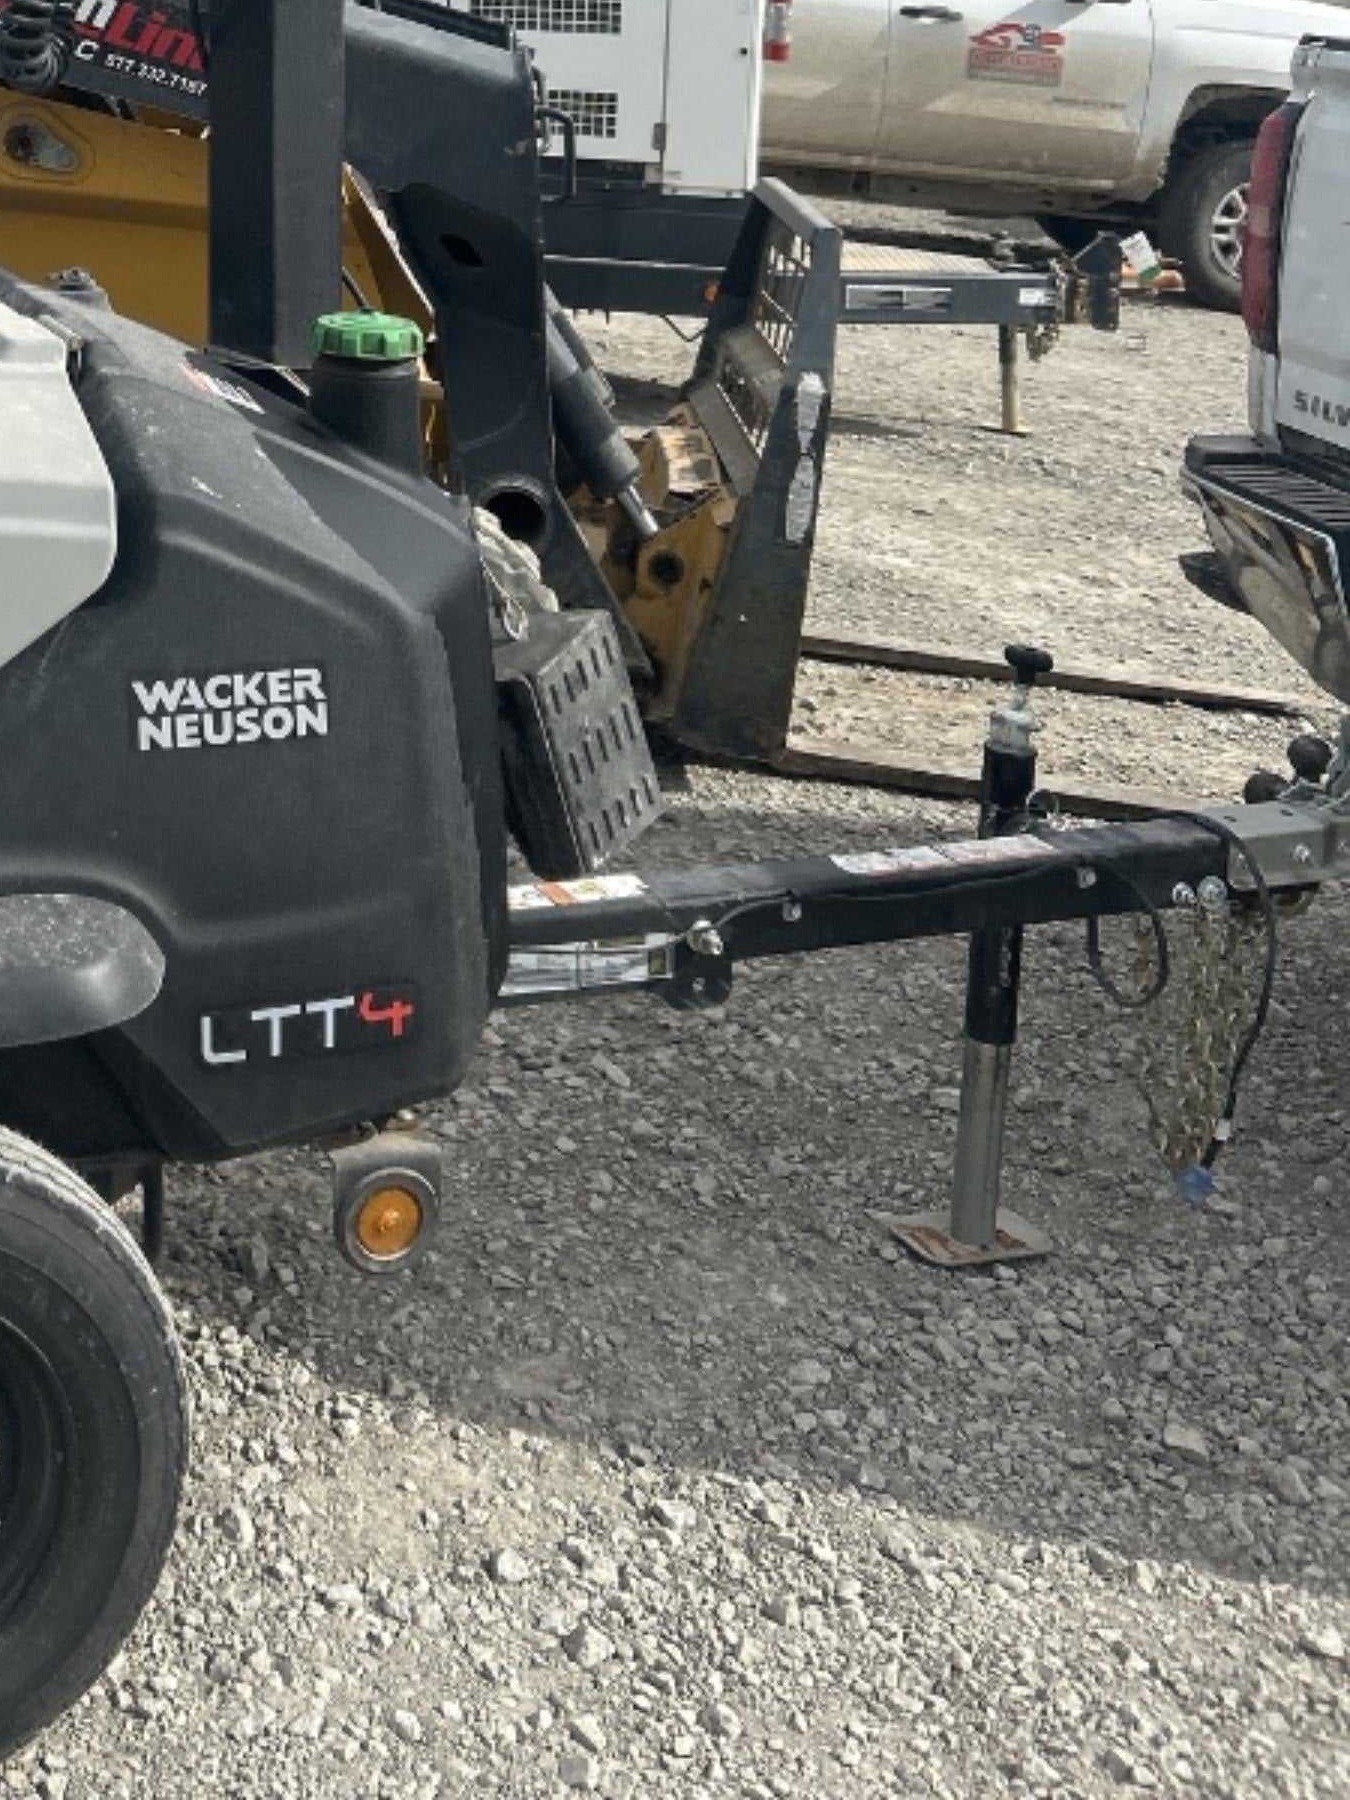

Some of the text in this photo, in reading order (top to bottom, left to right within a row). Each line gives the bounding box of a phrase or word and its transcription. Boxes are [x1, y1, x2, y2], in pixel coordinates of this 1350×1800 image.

[131, 668, 327, 714] WACKER
[138, 702, 329, 751] NEUSON
[200, 992, 415, 1065] LTT4
